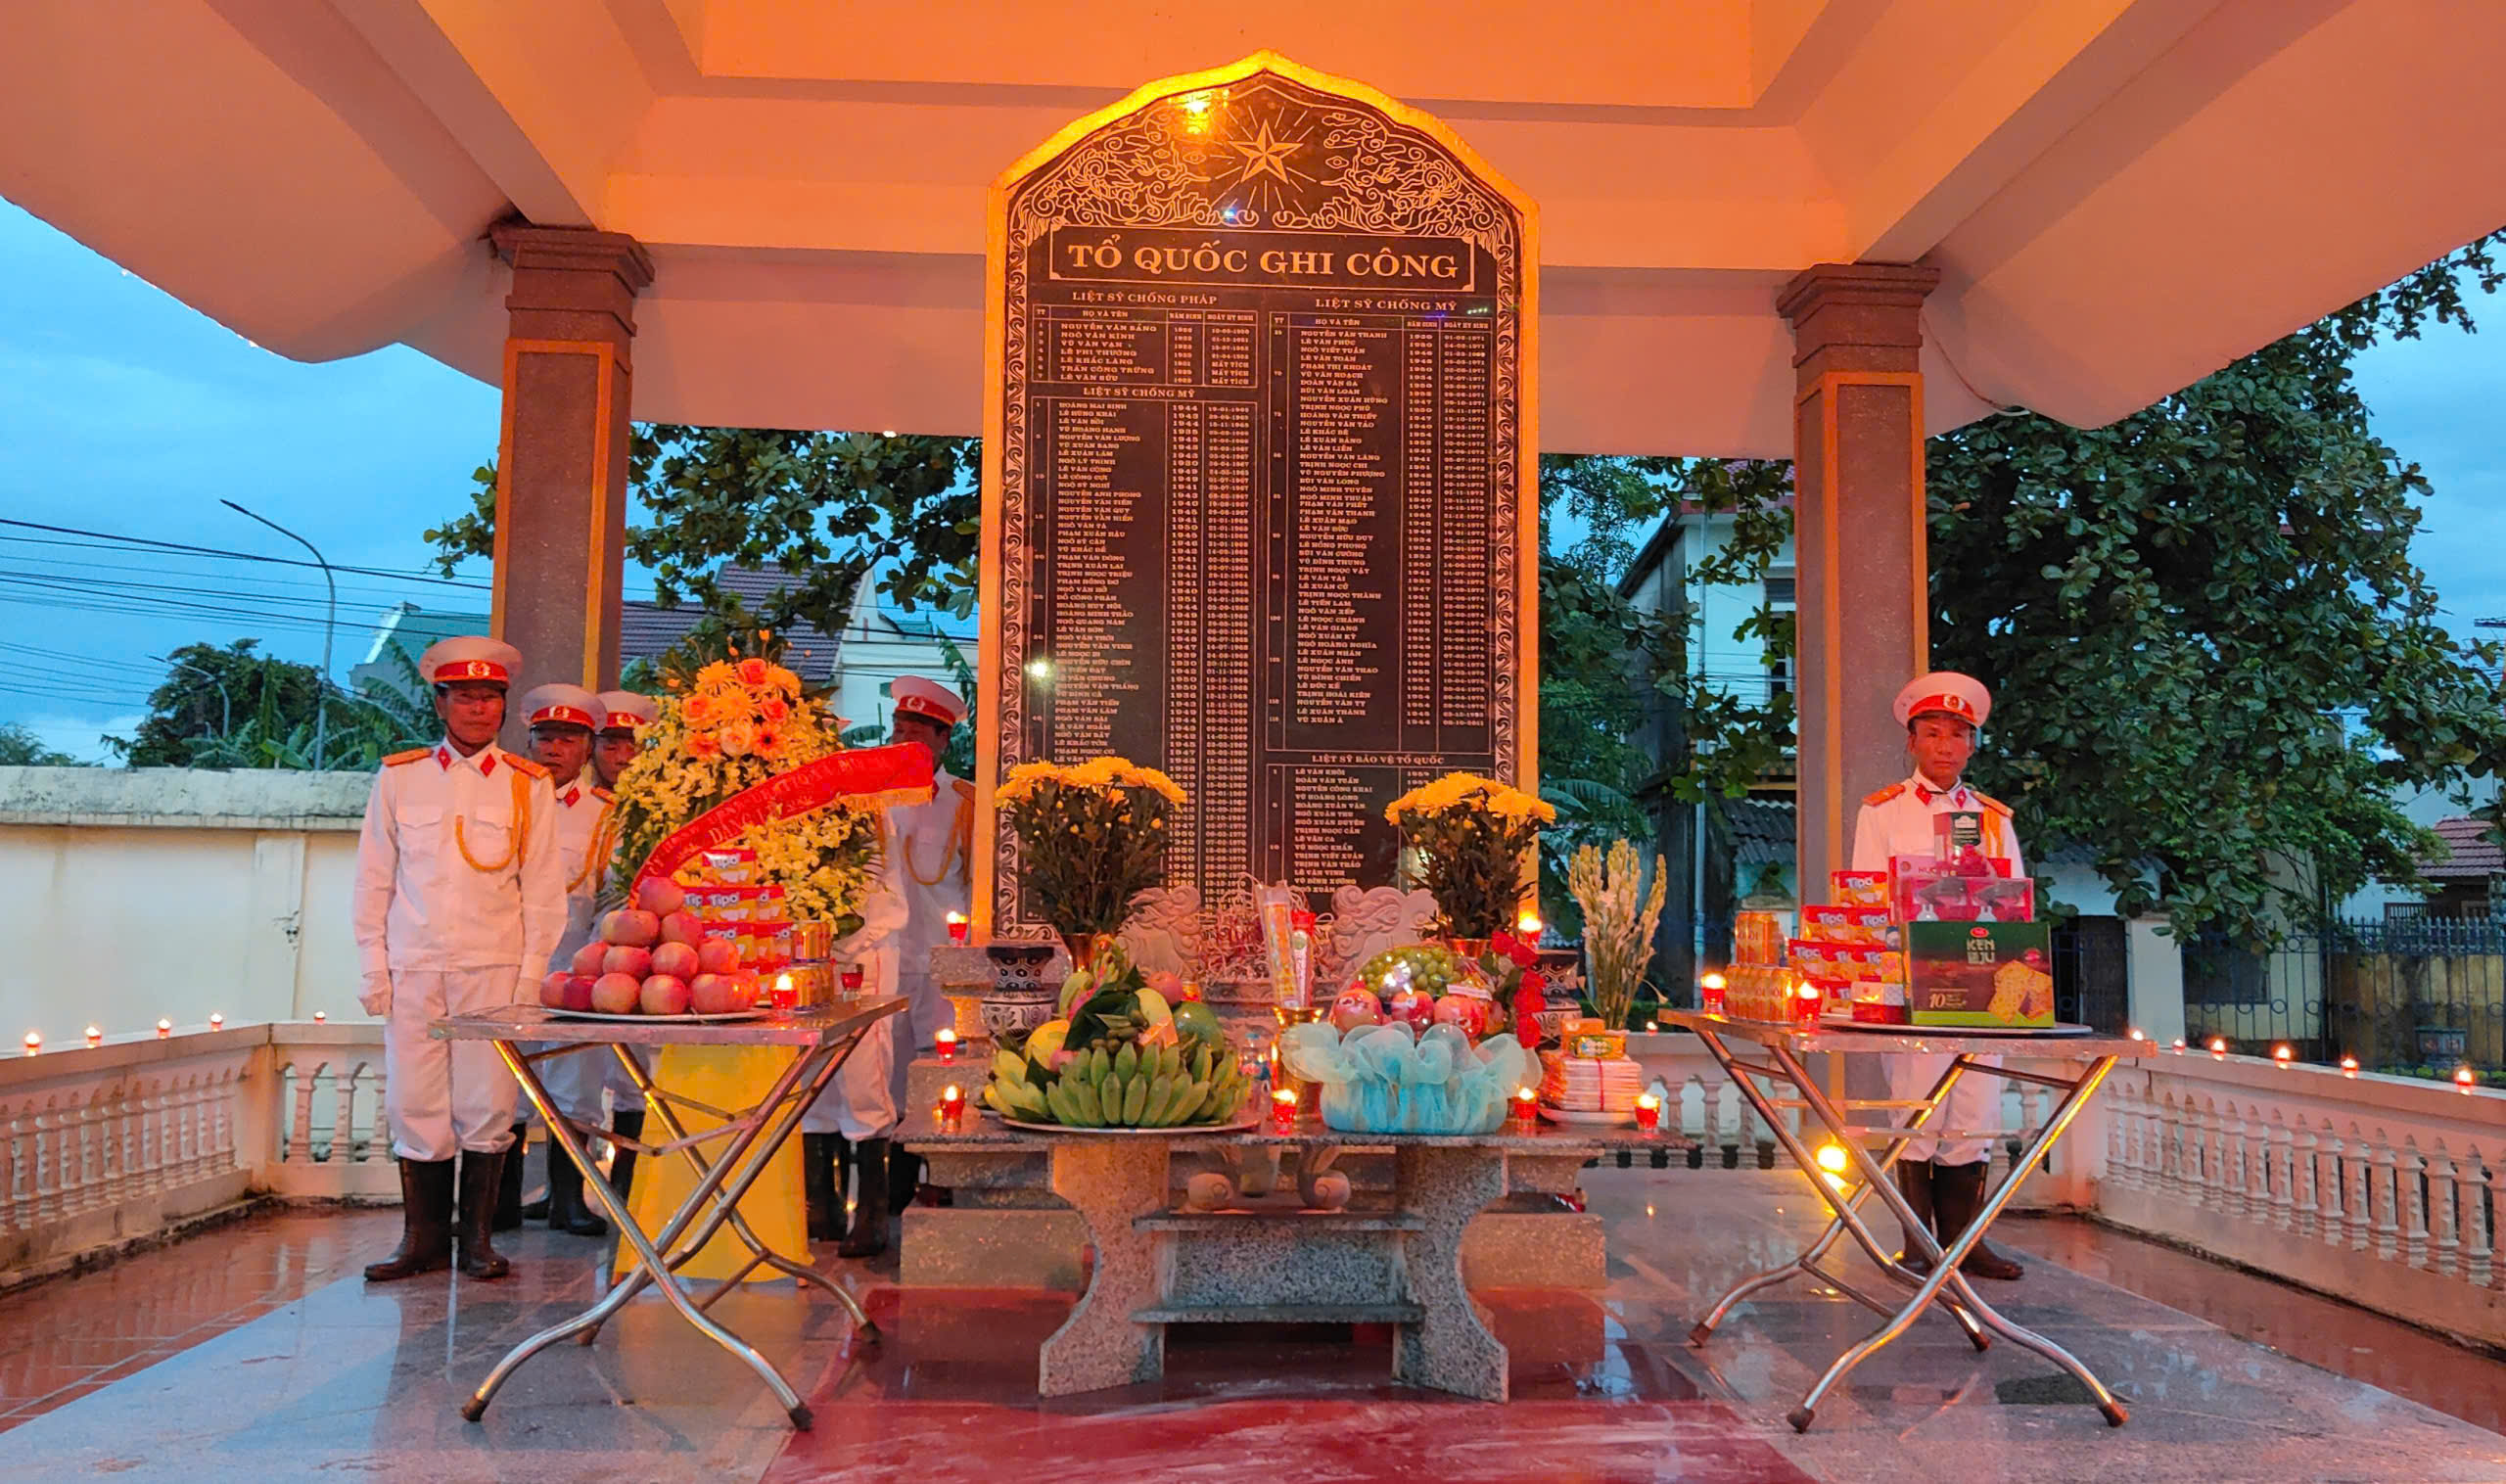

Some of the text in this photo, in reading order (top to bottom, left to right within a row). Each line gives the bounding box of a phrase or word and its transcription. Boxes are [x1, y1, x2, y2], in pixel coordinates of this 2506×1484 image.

[1068, 233, 1459, 278] TỔ QUỐC GHI CÔNG
[1072, 292, 1104, 302] LIỆT
[1128, 291, 1176, 303] CHỐNG
[1181, 294, 1218, 305] PHÁP
[1316, 299, 1350, 309] LIỆT
[1376, 299, 1431, 311] CHỐNG
[1084, 387, 1112, 397] LIỆT
[1132, 387, 1174, 398] CHỐNG
[1845, 877, 1873, 889] Tipo
[684, 894, 703, 906] Tip
[708, 892, 740, 907] Tipo
[1817, 912, 1845, 924] Tipo
[1860, 913, 1888, 927] Tipo
[1865, 951, 1881, 964] Tip
[1929, 994, 1946, 1008] 10
